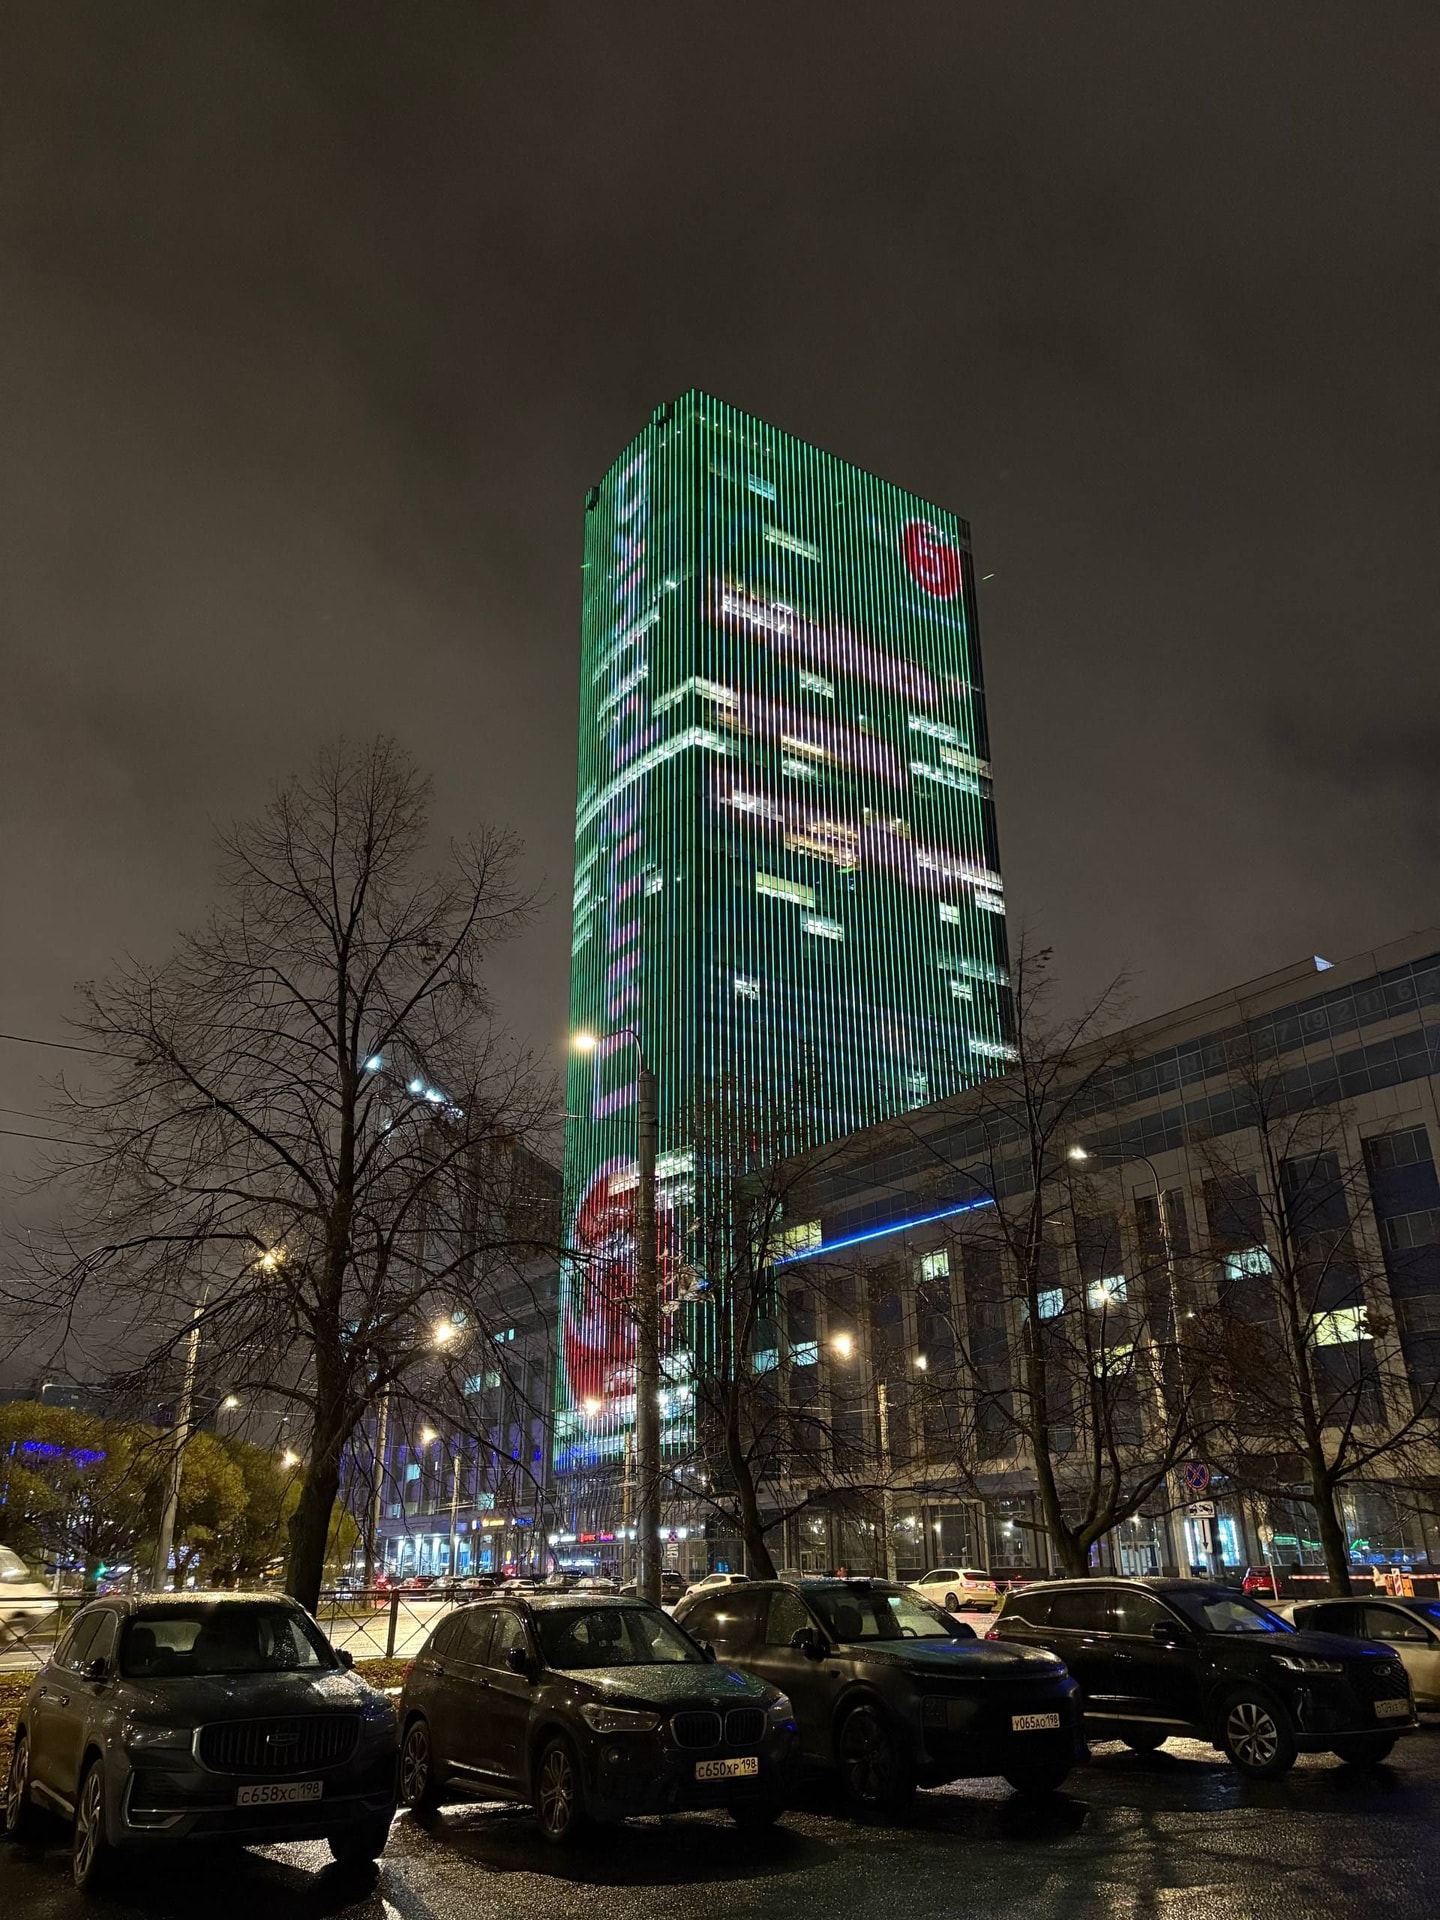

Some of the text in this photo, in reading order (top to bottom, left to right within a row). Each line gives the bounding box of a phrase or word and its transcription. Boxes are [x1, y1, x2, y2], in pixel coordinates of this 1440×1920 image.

[917, 536, 943, 584] 5
[1014, 1714, 1059, 1730] У065АО 198
[698, 1758, 757, 1778] С650ХР 198
[241, 1782, 320, 1804] С658ХС 198
